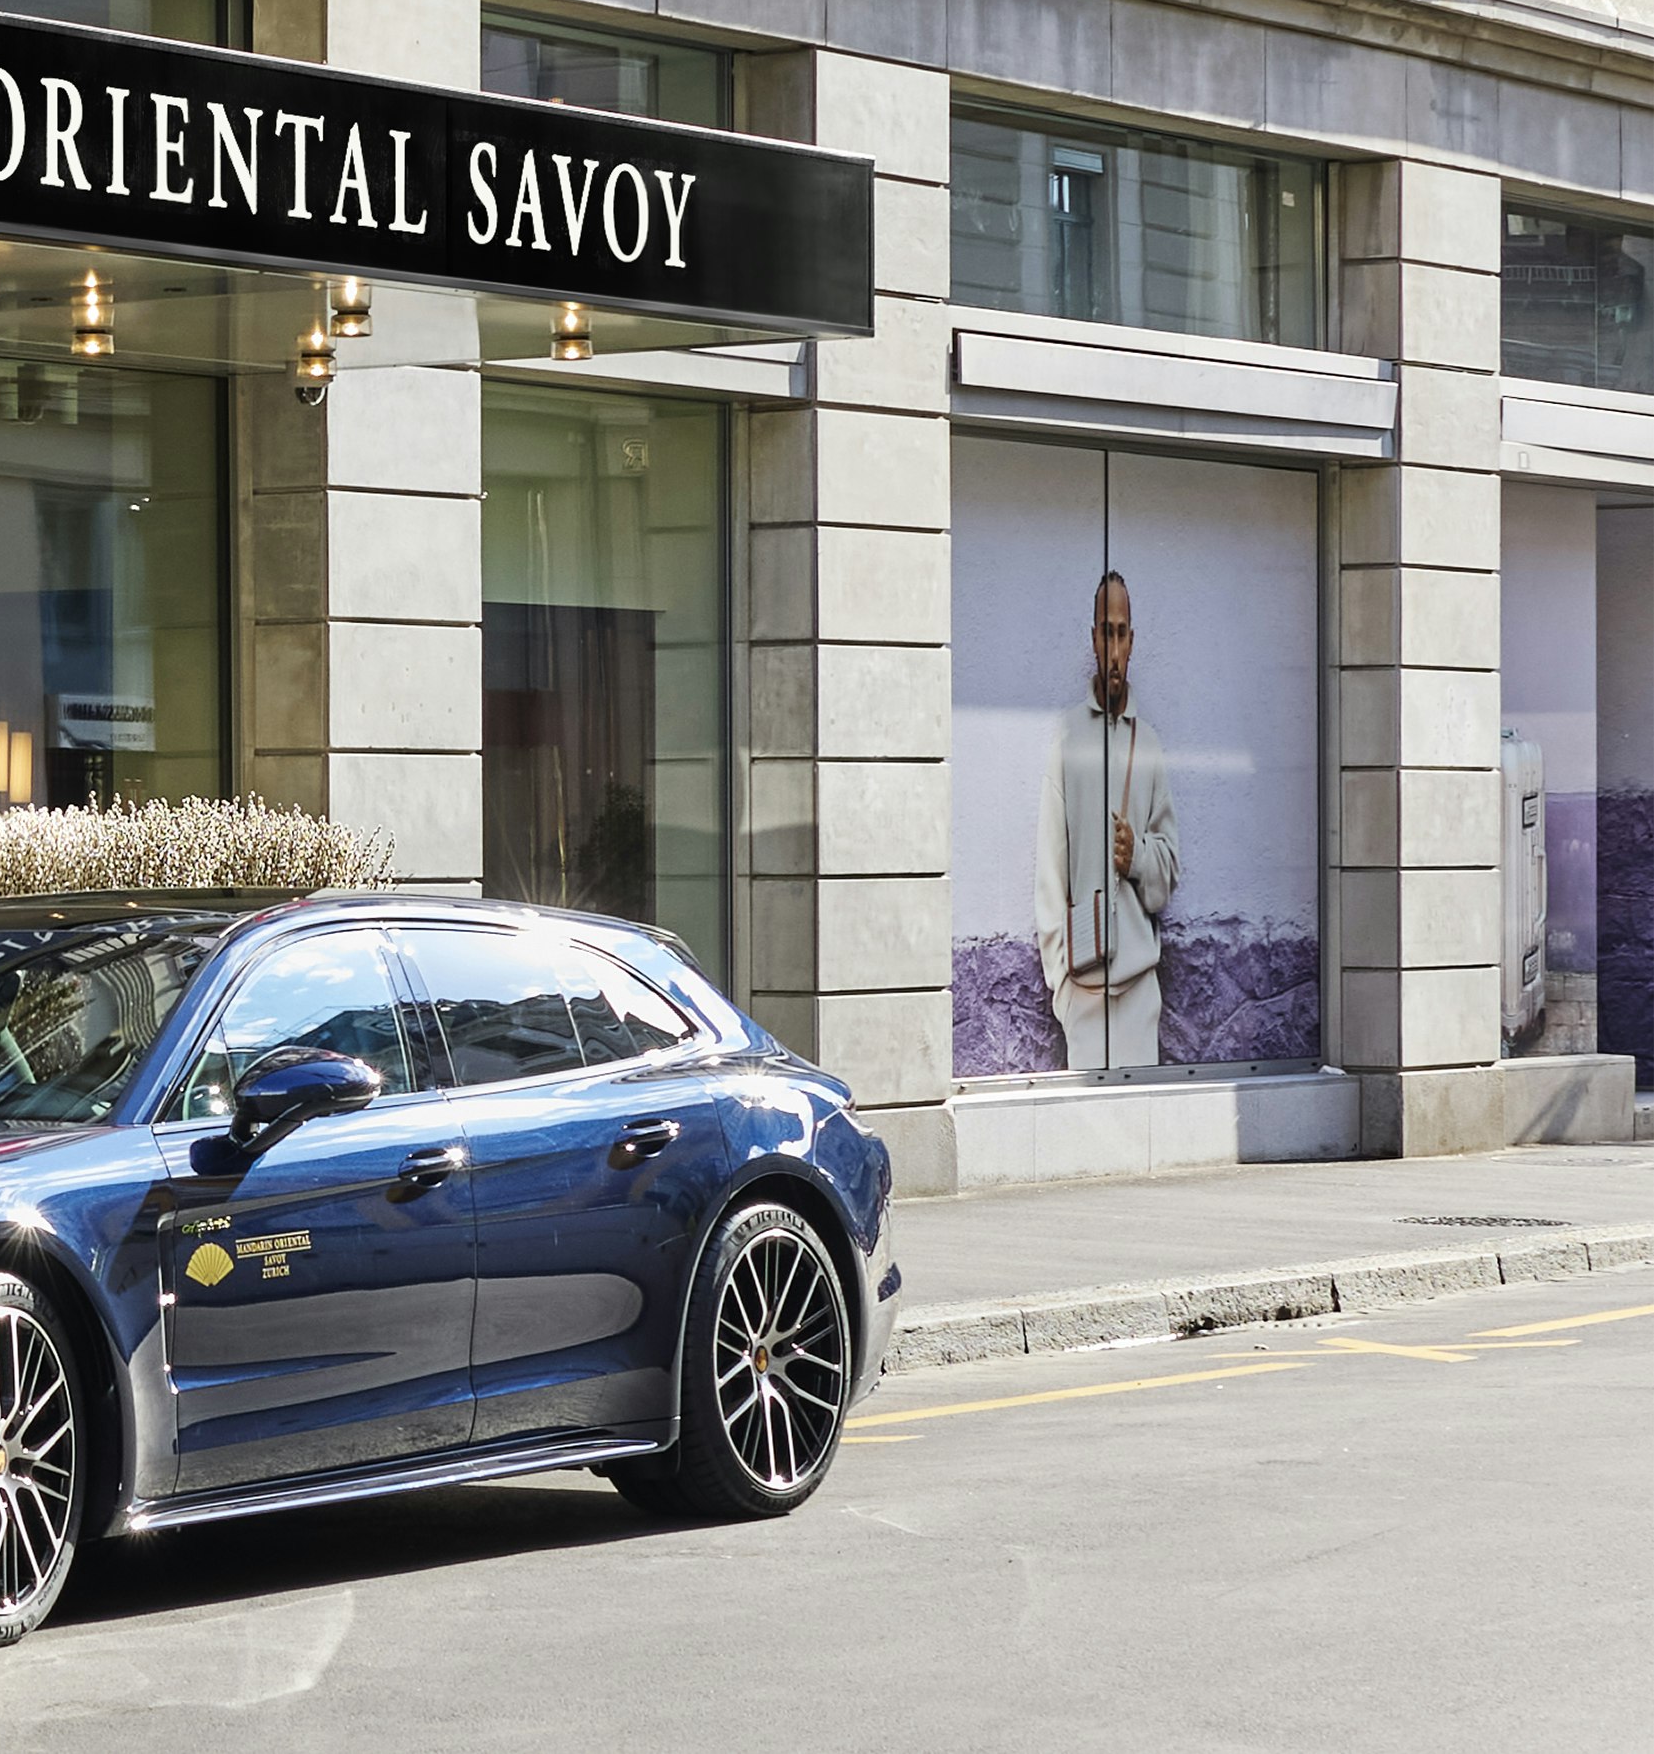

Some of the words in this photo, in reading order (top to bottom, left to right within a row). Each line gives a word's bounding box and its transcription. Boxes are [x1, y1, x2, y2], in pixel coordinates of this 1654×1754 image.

[467, 141, 697, 268] SAVOY
[749, 1210, 805, 1231] MICHELIN
[235, 1238, 273, 1254] MANDARIN
[273, 1234, 311, 1249] ORIENTAL
[263, 1253, 287, 1265] SAVOY
[262, 1265, 290, 1279] ZURICH
